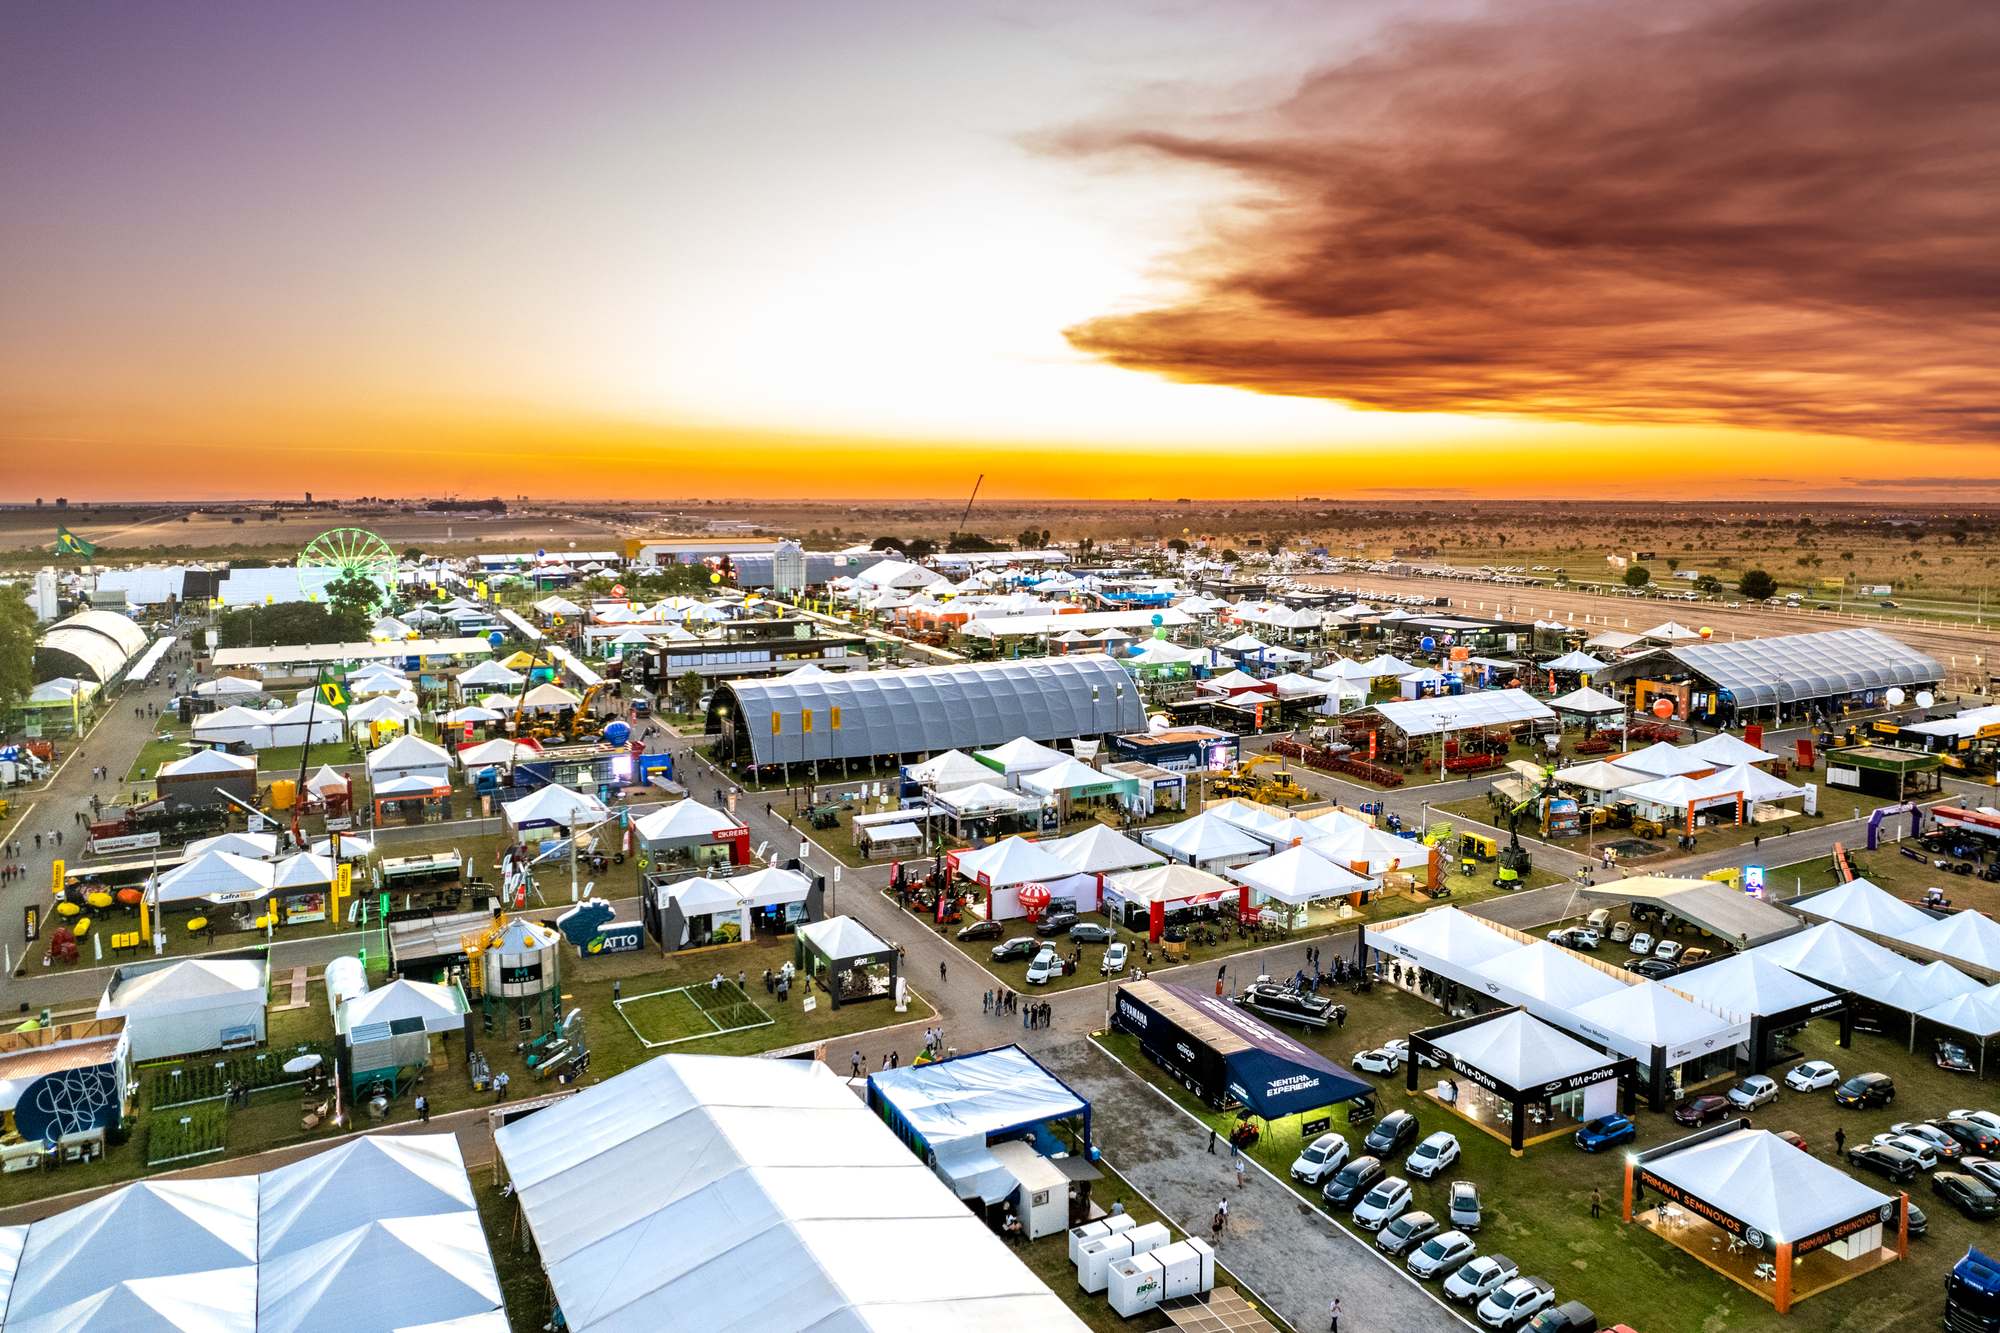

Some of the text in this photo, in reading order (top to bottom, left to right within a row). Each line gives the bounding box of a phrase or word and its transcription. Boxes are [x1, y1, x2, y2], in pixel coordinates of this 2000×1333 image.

[603, 934, 638, 950] ATTO
[1126, 1003, 1148, 1027] YAMAHA
[1810, 999, 1842, 1013] DEFENDER
[1268, 1074, 1310, 1087] VENTURA
[1467, 1067, 1496, 1089] e-Drive
[1583, 1068, 1613, 1083] e-Drive
[1266, 1078, 1320, 1097] EXPERIENCE
[1641, 1172, 1680, 1200] PRIMAVIA
[1683, 1195, 1740, 1232] SEMINOVOS
[1834, 1212, 1877, 1237] SEMINOVOS
[1798, 1232, 1831, 1254] PRIMAVIA
